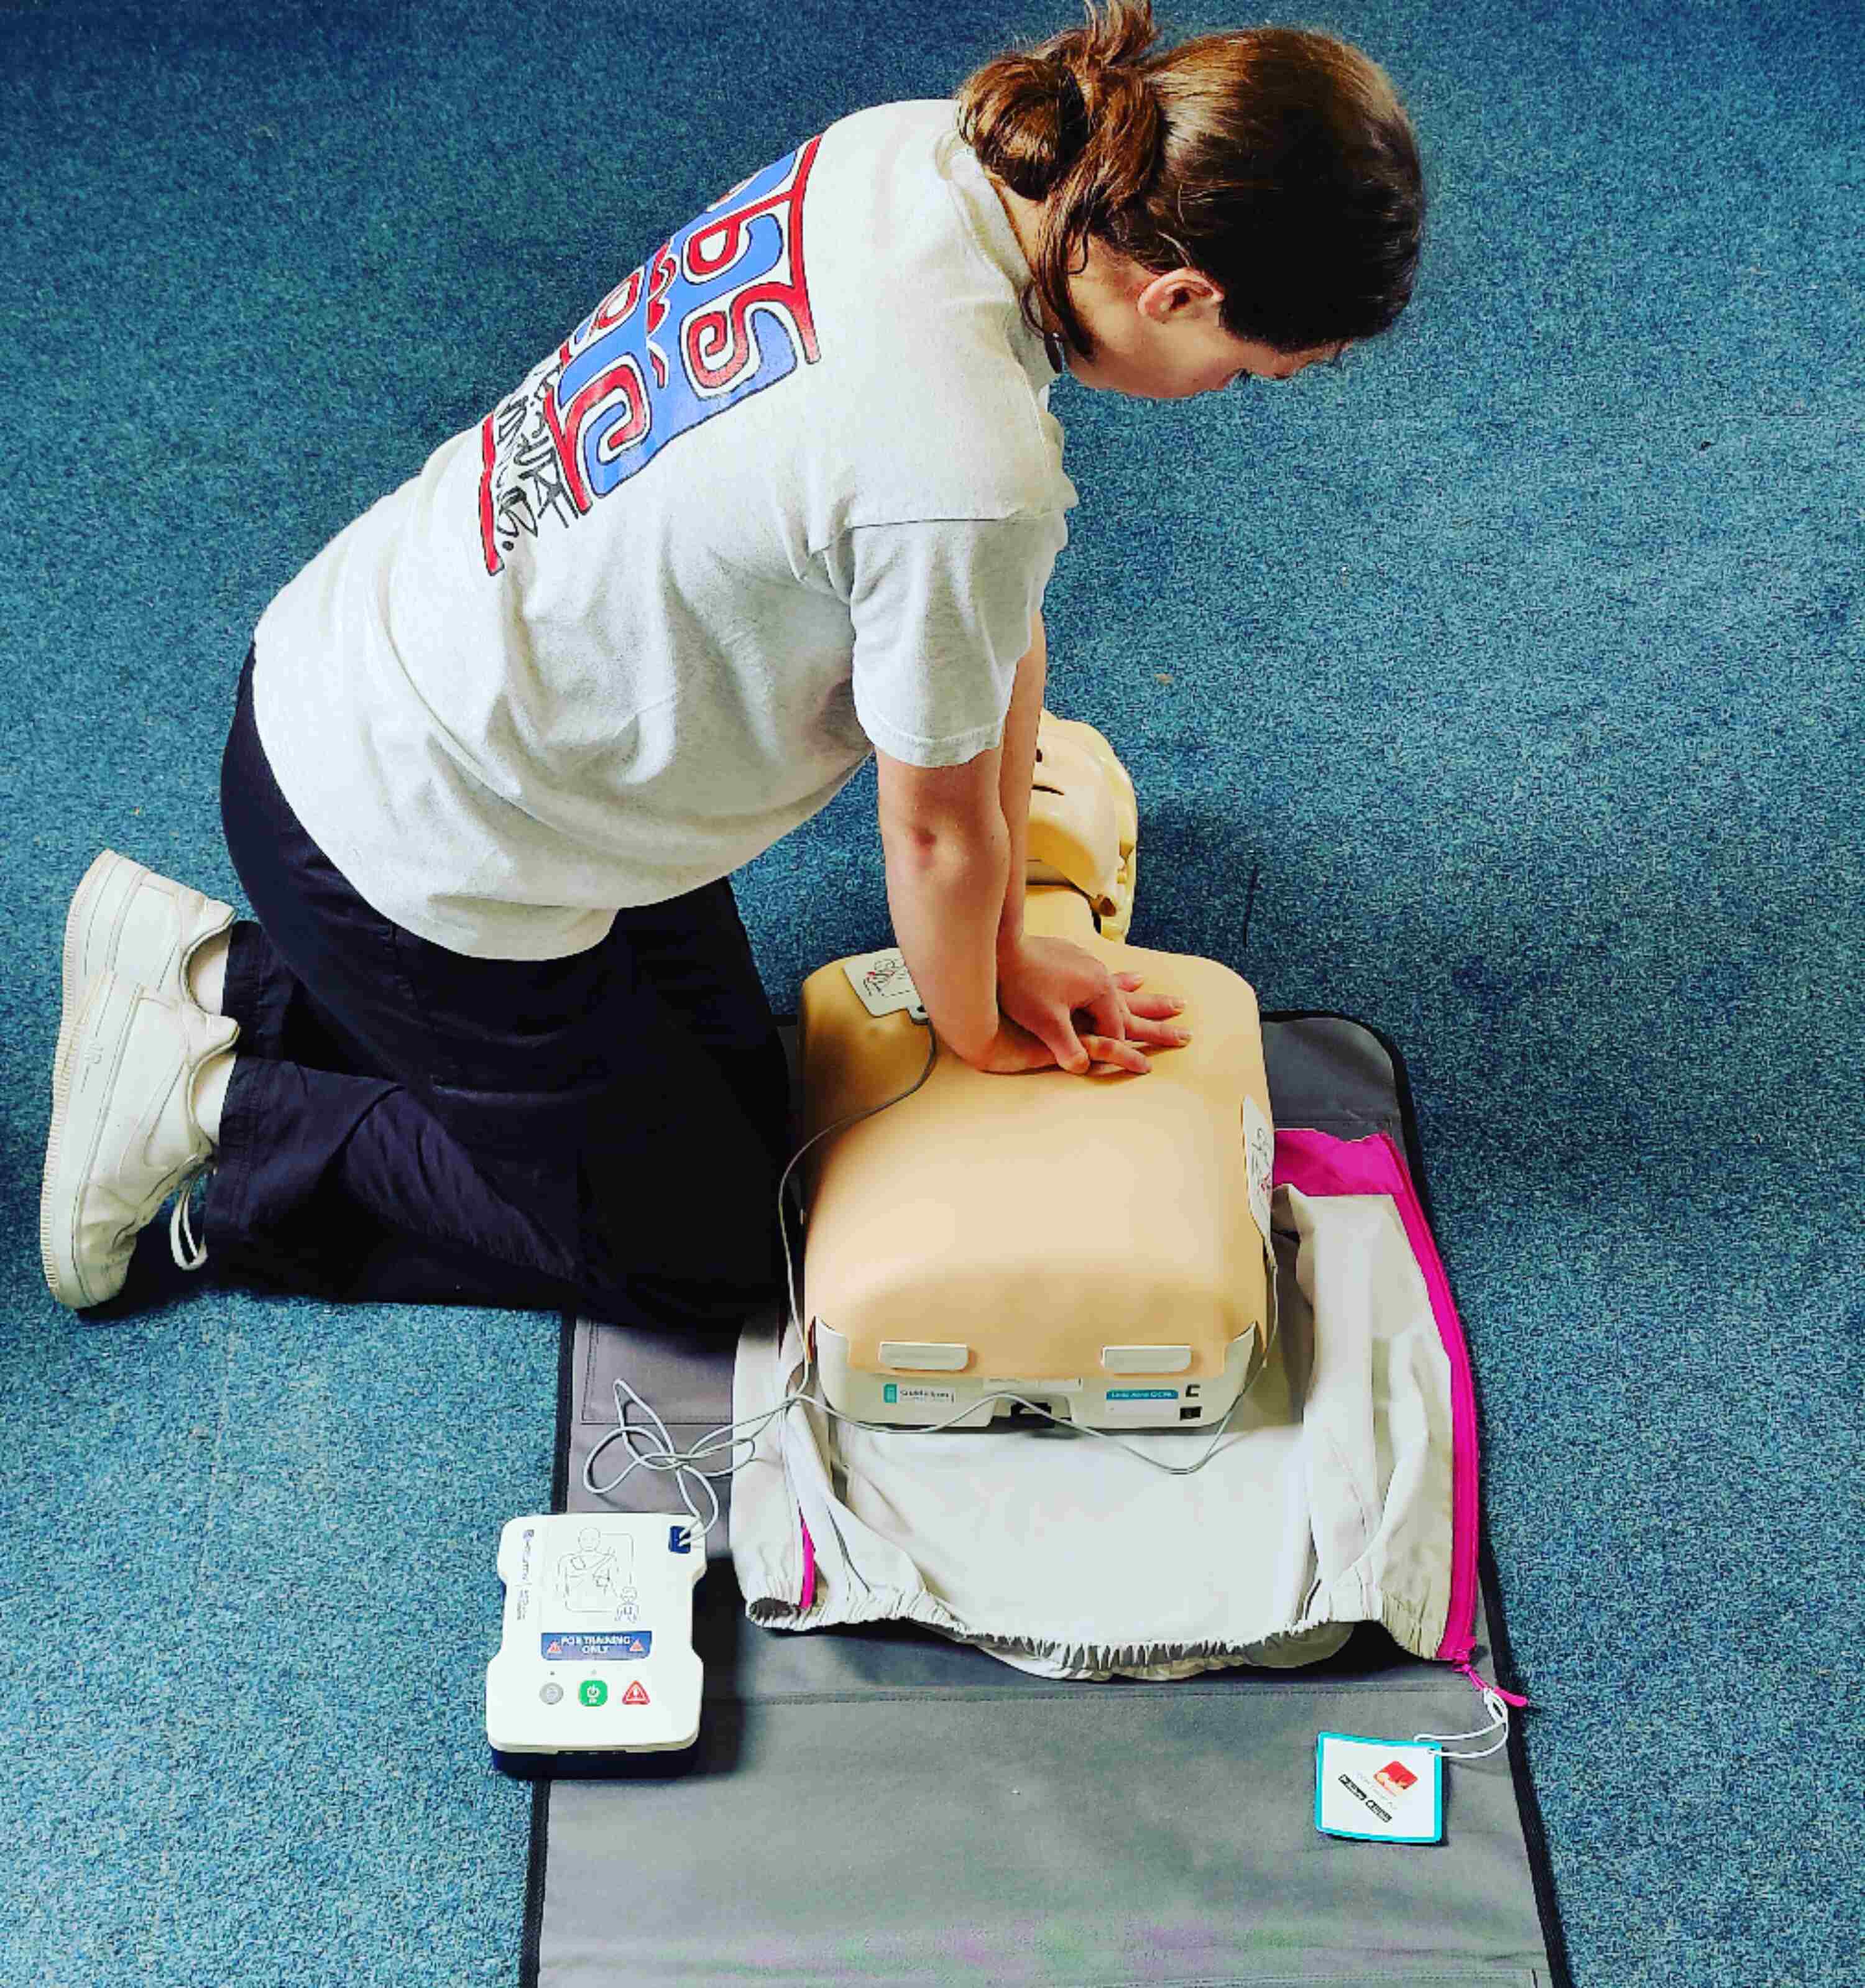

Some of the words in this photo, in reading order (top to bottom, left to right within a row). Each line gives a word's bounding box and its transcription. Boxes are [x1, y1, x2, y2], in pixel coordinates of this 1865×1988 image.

[561, 1636, 581, 1645] FOR
[583, 1634, 630, 1645] TRAINING
[582, 1645, 609, 1654] ONLY
